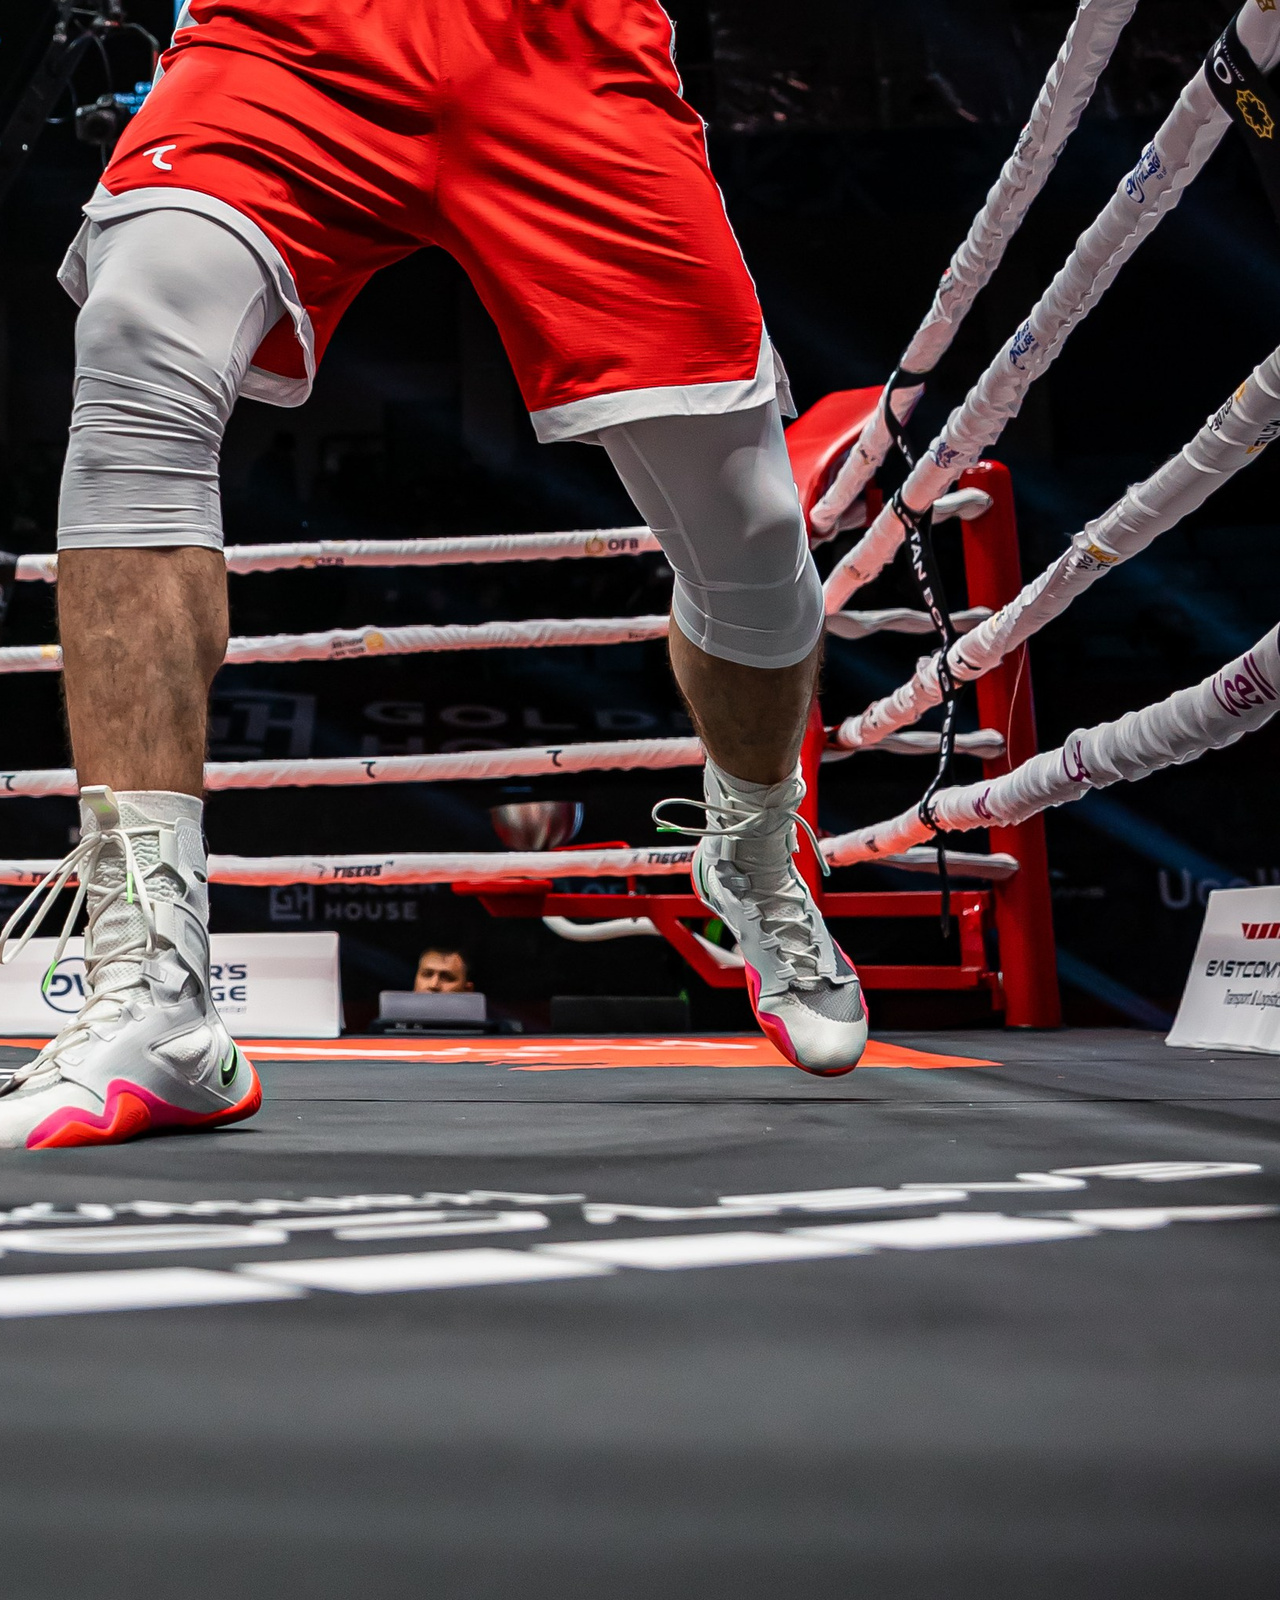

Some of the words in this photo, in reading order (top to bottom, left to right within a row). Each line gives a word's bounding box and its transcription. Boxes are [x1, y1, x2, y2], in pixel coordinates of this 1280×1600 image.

[608, 538, 639, 550] OFB
[362, 700, 690, 732] GOLD
[334, 864, 382, 878] TIGERS
[324, 902, 418, 921] HOUSE
